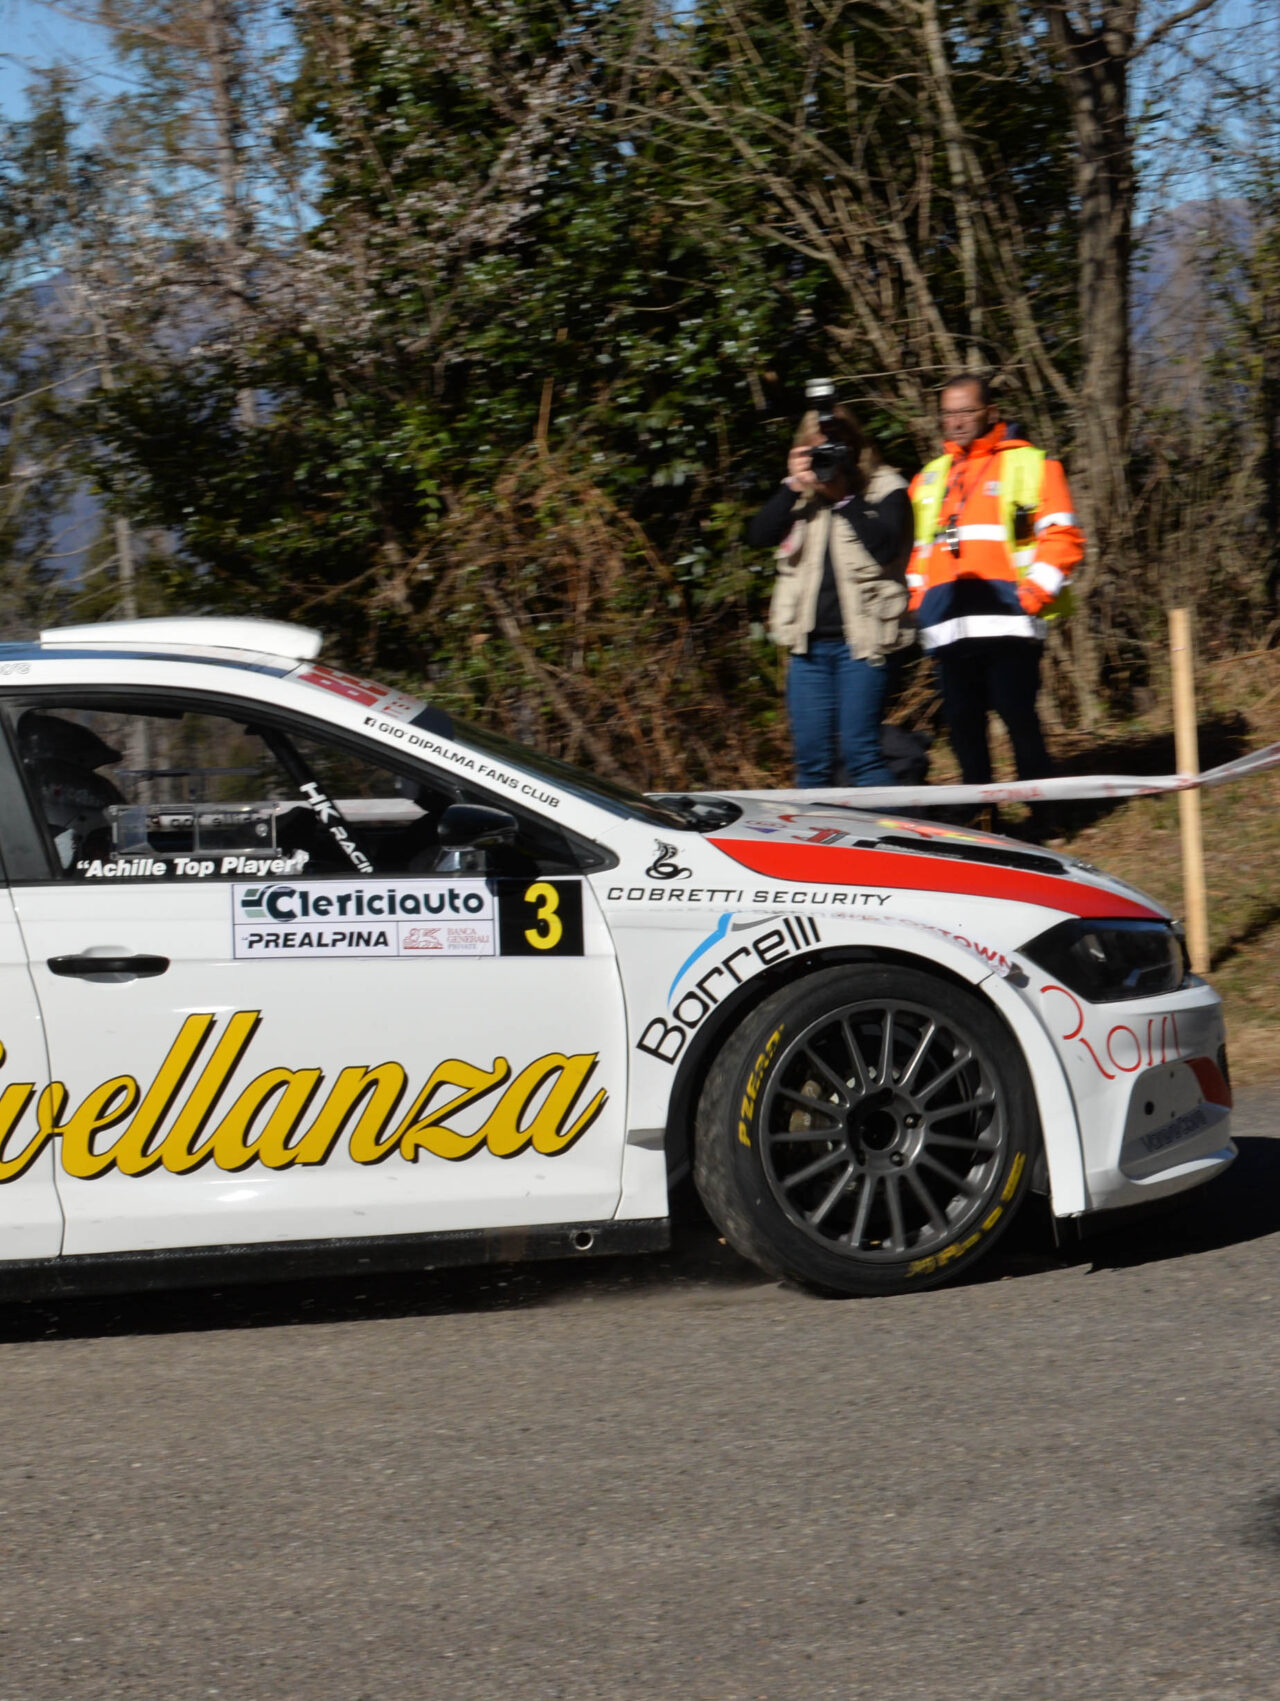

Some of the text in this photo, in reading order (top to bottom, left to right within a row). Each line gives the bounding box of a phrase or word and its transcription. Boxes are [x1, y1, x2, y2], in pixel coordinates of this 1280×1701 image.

[408, 734, 475, 770] DIPALMA
[477, 764, 520, 789] FANS
[521, 783, 562, 808] CLUB
[299, 782, 340, 823] HK
[174, 857, 215, 878] Top
[270, 886, 484, 921] Clericiauto
[607, 887, 893, 906] COBRETTI SECURITY
[524, 882, 564, 950] 3
[248, 931, 389, 949] PREALPINA
